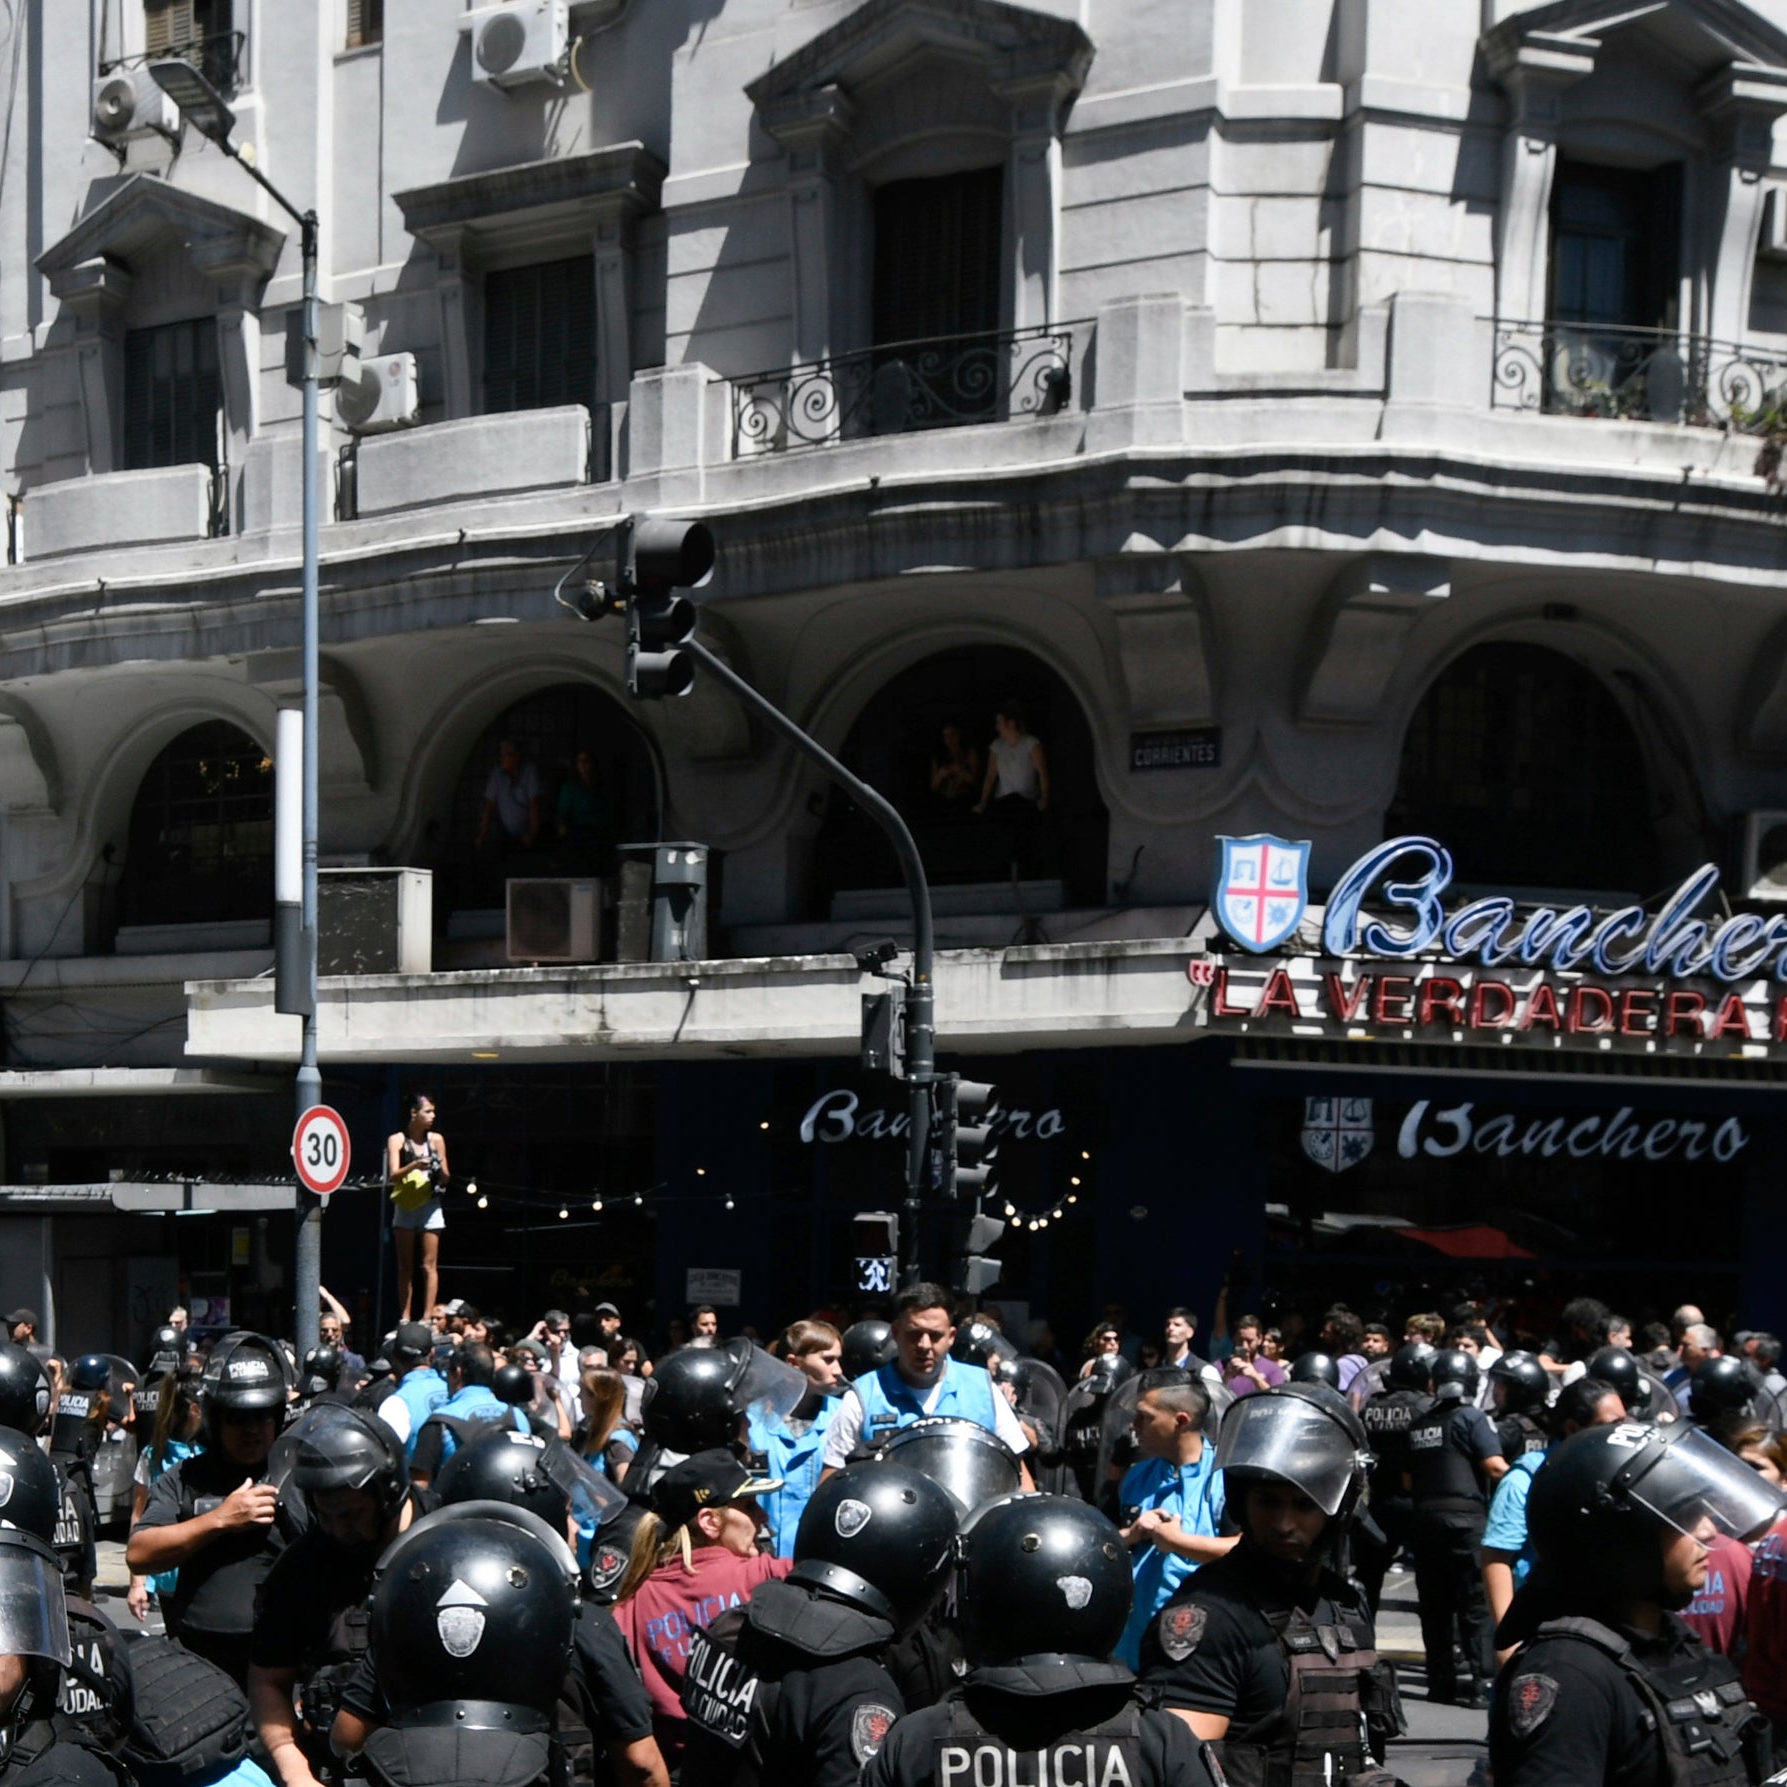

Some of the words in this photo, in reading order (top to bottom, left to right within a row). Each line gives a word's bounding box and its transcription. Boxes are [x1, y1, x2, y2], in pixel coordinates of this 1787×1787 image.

[1325, 972, 1753, 1041] VERDADERA
[307, 1132, 337, 1167] 30
[1396, 1099, 1750, 1162] Banchero
[132, 1391, 160, 1404] POLICI
